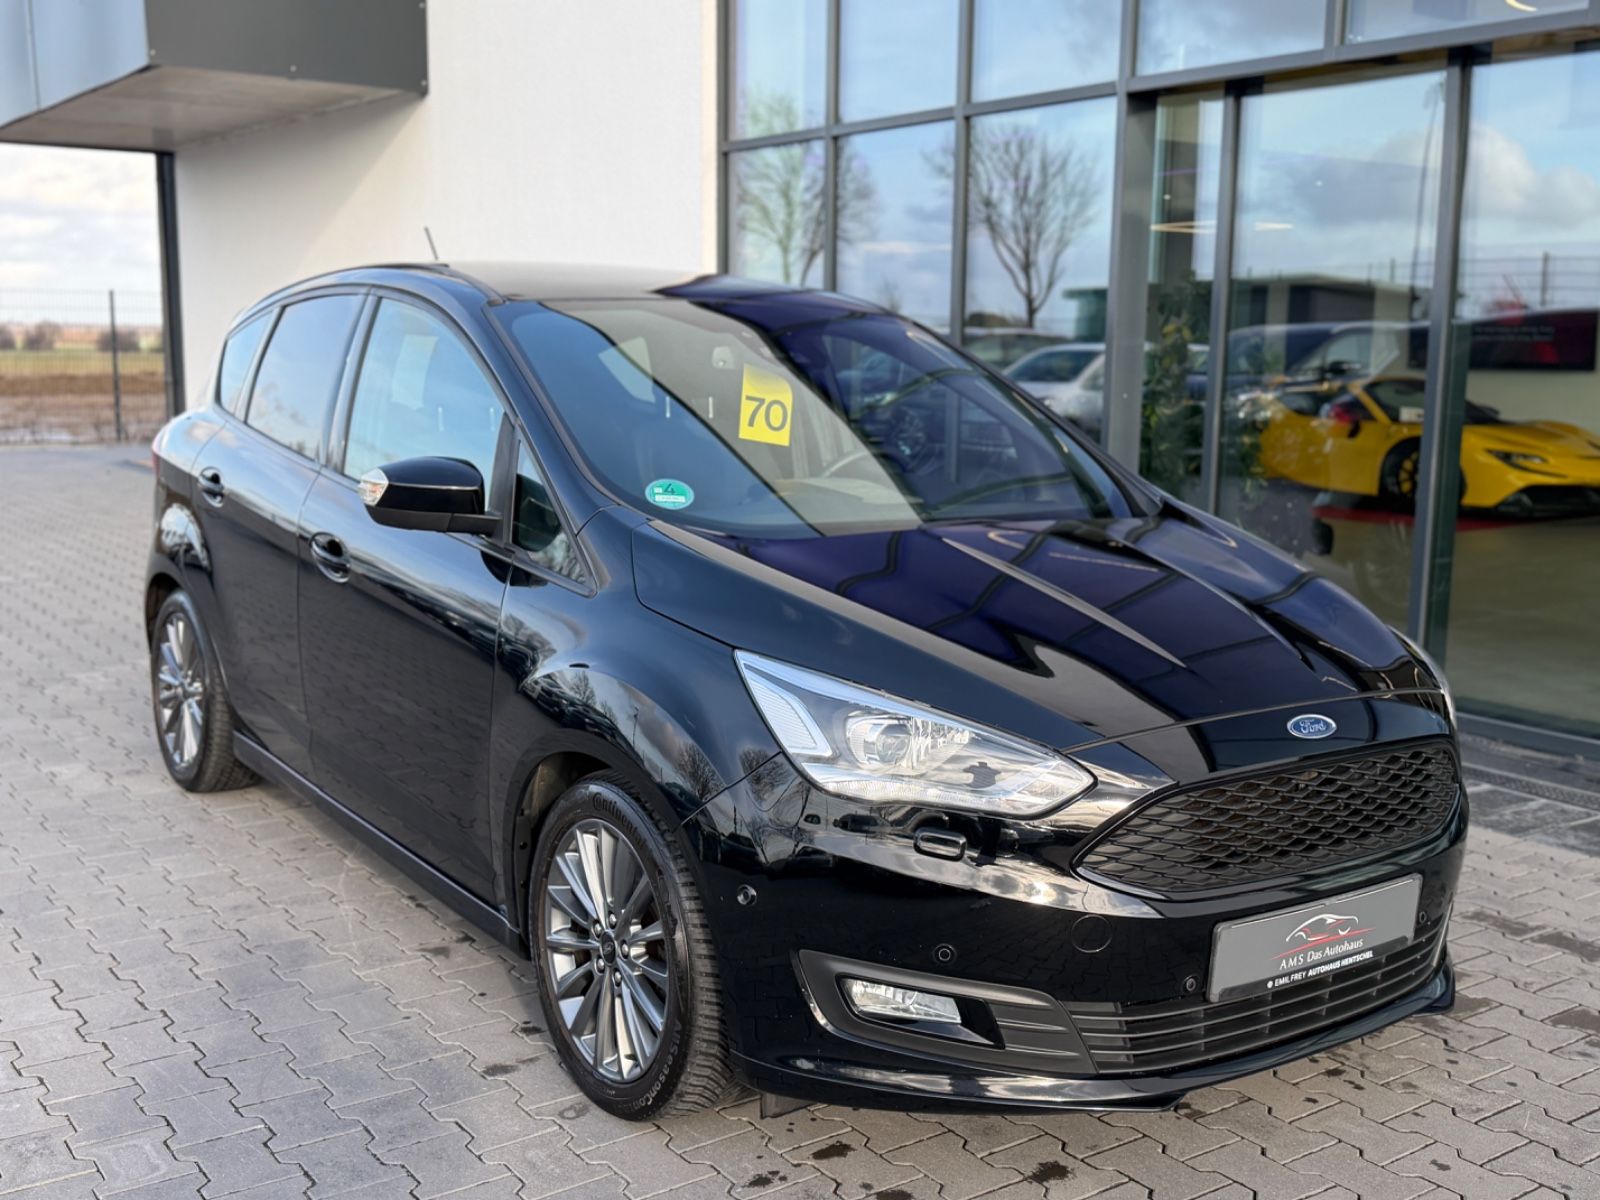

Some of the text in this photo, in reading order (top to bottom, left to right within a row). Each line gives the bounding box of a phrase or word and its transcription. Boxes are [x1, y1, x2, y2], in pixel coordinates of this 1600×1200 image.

[744, 395, 789, 432] 70
[663, 483, 676, 495] 4
[1299, 719, 1327, 734] Ford
[1307, 950, 1323, 962] Das
[1323, 938, 1364, 957] Autohaus
[1274, 976, 1291, 987] EMIL
[1290, 971, 1307, 982] FREY
[1307, 960, 1341, 977] AUTOHAUS
